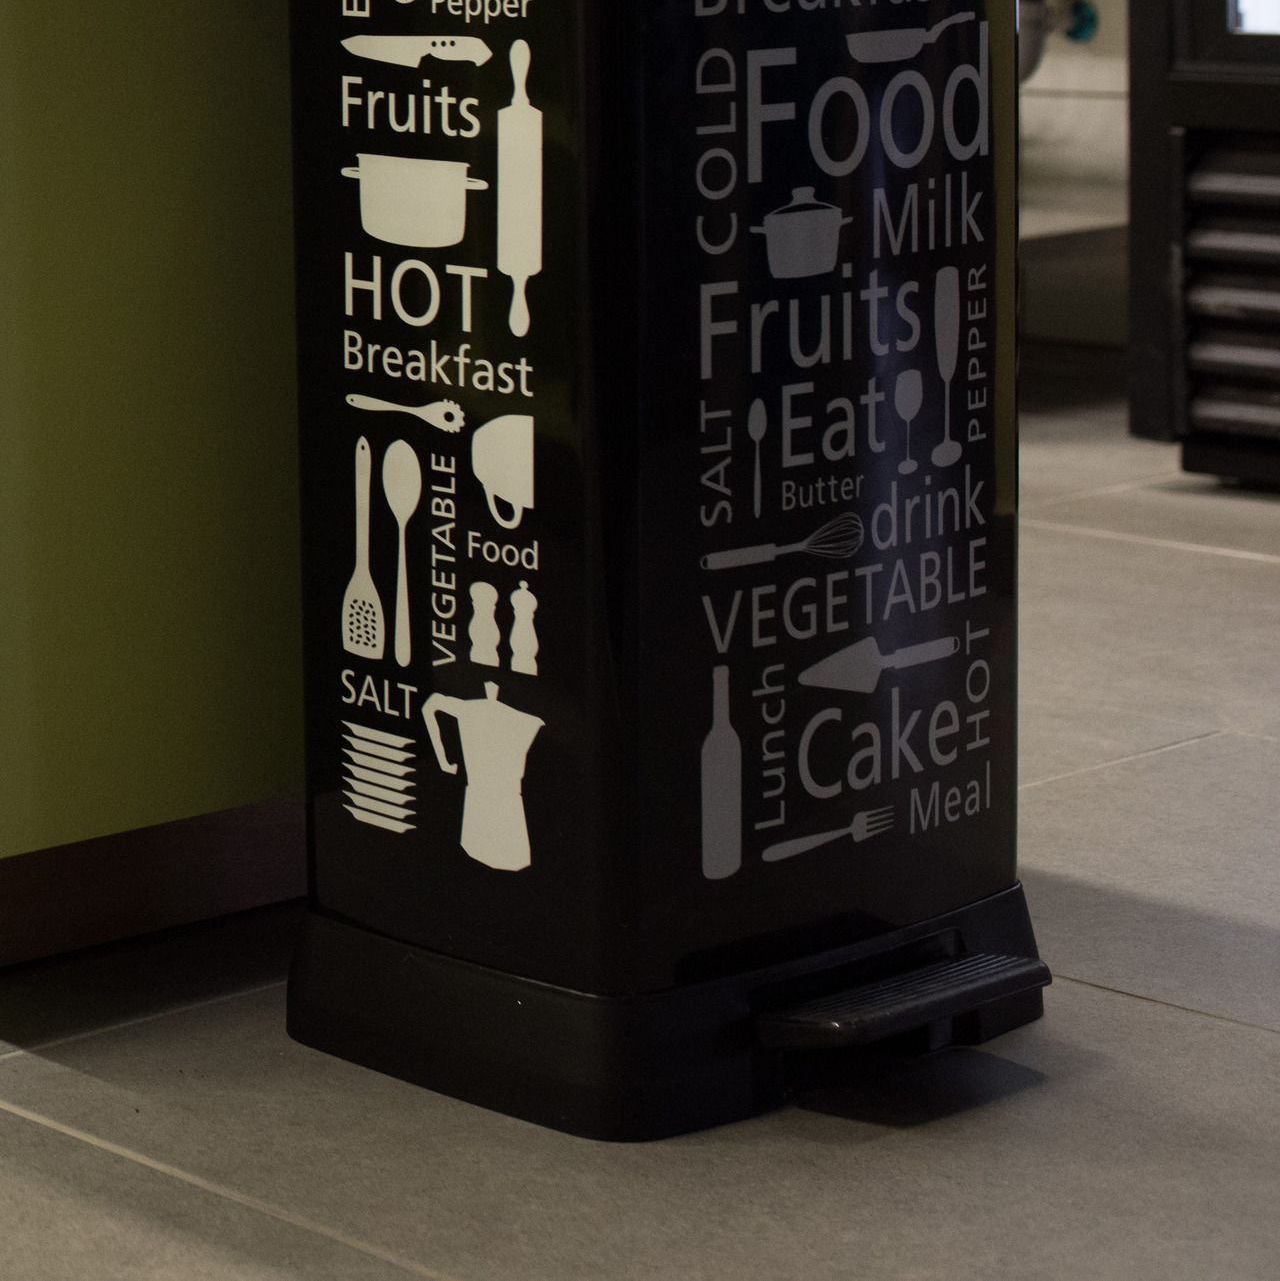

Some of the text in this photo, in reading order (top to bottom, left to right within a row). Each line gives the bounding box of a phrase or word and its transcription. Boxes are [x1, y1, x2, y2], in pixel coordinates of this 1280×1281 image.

[341, 75, 481, 138] Fruits
[696, 47, 737, 255] COLD
[747, 21, 989, 183] Food
[873, 171, 984, 259] Milk
[344, 251, 488, 332] HOT
[700, 263, 921, 379] Fruits
[344, 329, 533, 397] Breakfast
[968, 264, 987, 442] PEPPER
[700, 400, 732, 527] SALT
[782, 377, 886, 468] Eat
[782, 474, 864, 511] Butter
[871, 464, 986, 550] drink
[431, 453, 456, 666] VEGETABLE
[468, 531, 538, 570] Food
[702, 538, 987, 654] VEGETABLE
[341, 669, 417, 719] SALT
[966, 620, 990, 751] HOT
[752, 664, 785, 830] Lunch
[798, 687, 959, 799] Cake
[910, 761, 990, 835] Meal
